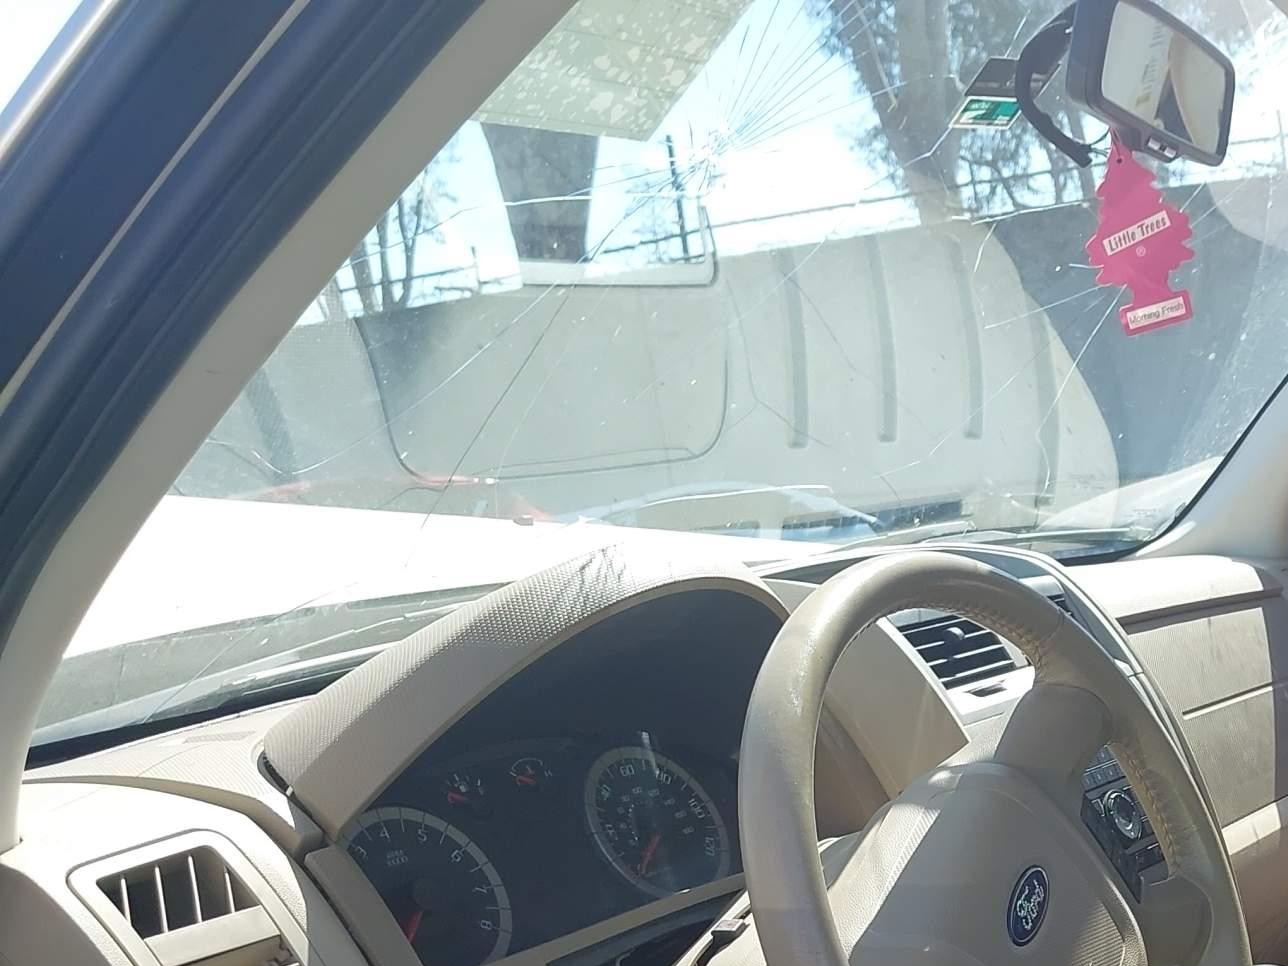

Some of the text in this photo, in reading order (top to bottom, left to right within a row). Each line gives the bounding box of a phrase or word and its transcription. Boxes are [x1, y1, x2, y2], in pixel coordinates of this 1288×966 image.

[1108, 217, 1167, 252] Little Trees
[1129, 302, 1184, 325] Morning Fresh
[417, 828, 428, 842] 5
[451, 850, 463, 863] 6
[1017, 879, 1045, 931] Ford
